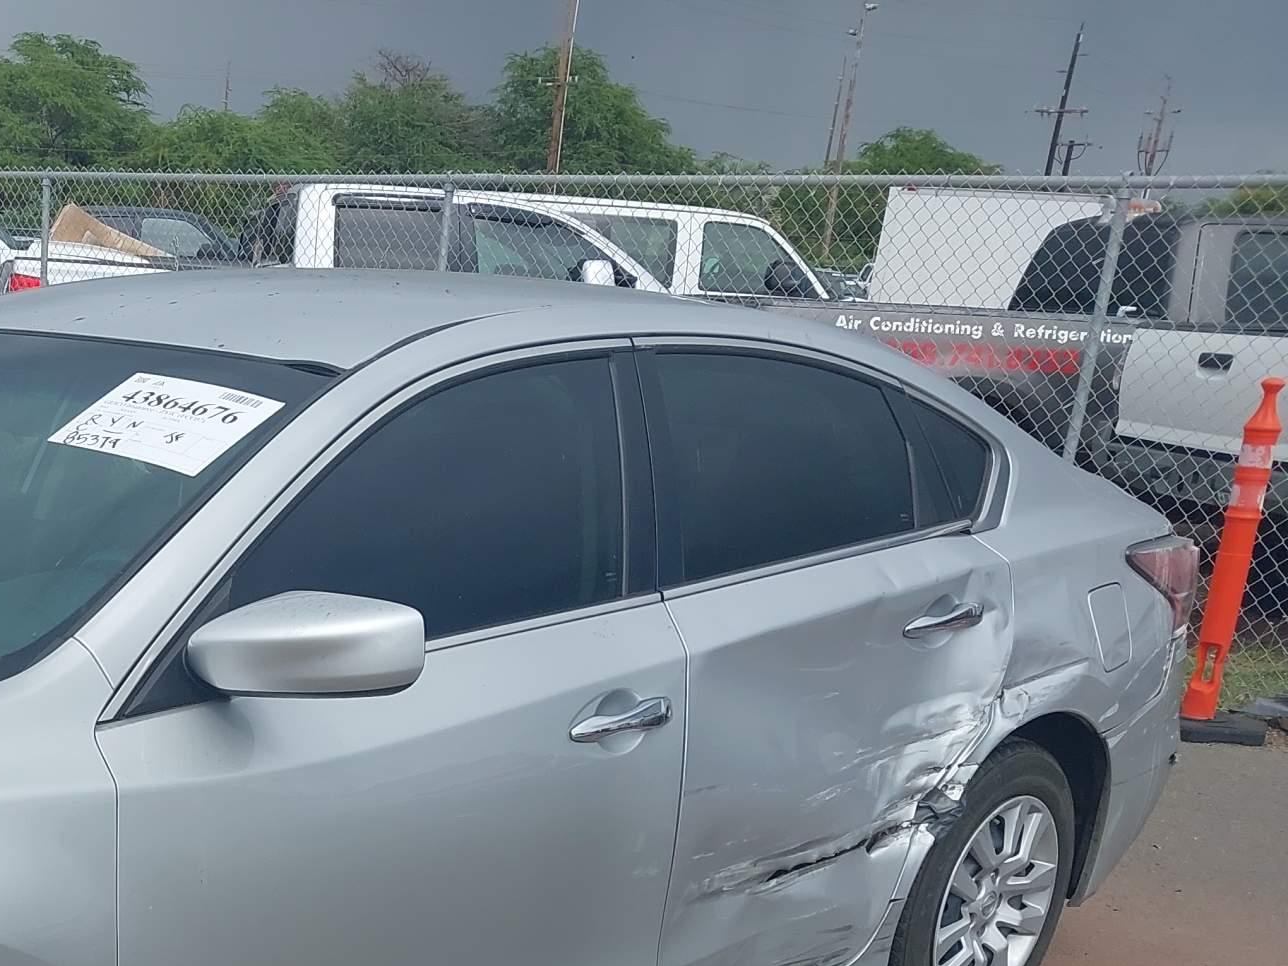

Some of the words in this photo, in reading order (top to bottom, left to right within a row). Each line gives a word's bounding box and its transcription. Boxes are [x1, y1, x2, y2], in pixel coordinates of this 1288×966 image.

[835, 315, 862, 330] Air
[869, 316, 983, 340] Conditioning
[991, 322, 1005, 337] &
[1013, 323, 1132, 344] Refrigertion
[122, 390, 247, 424] 43864676
